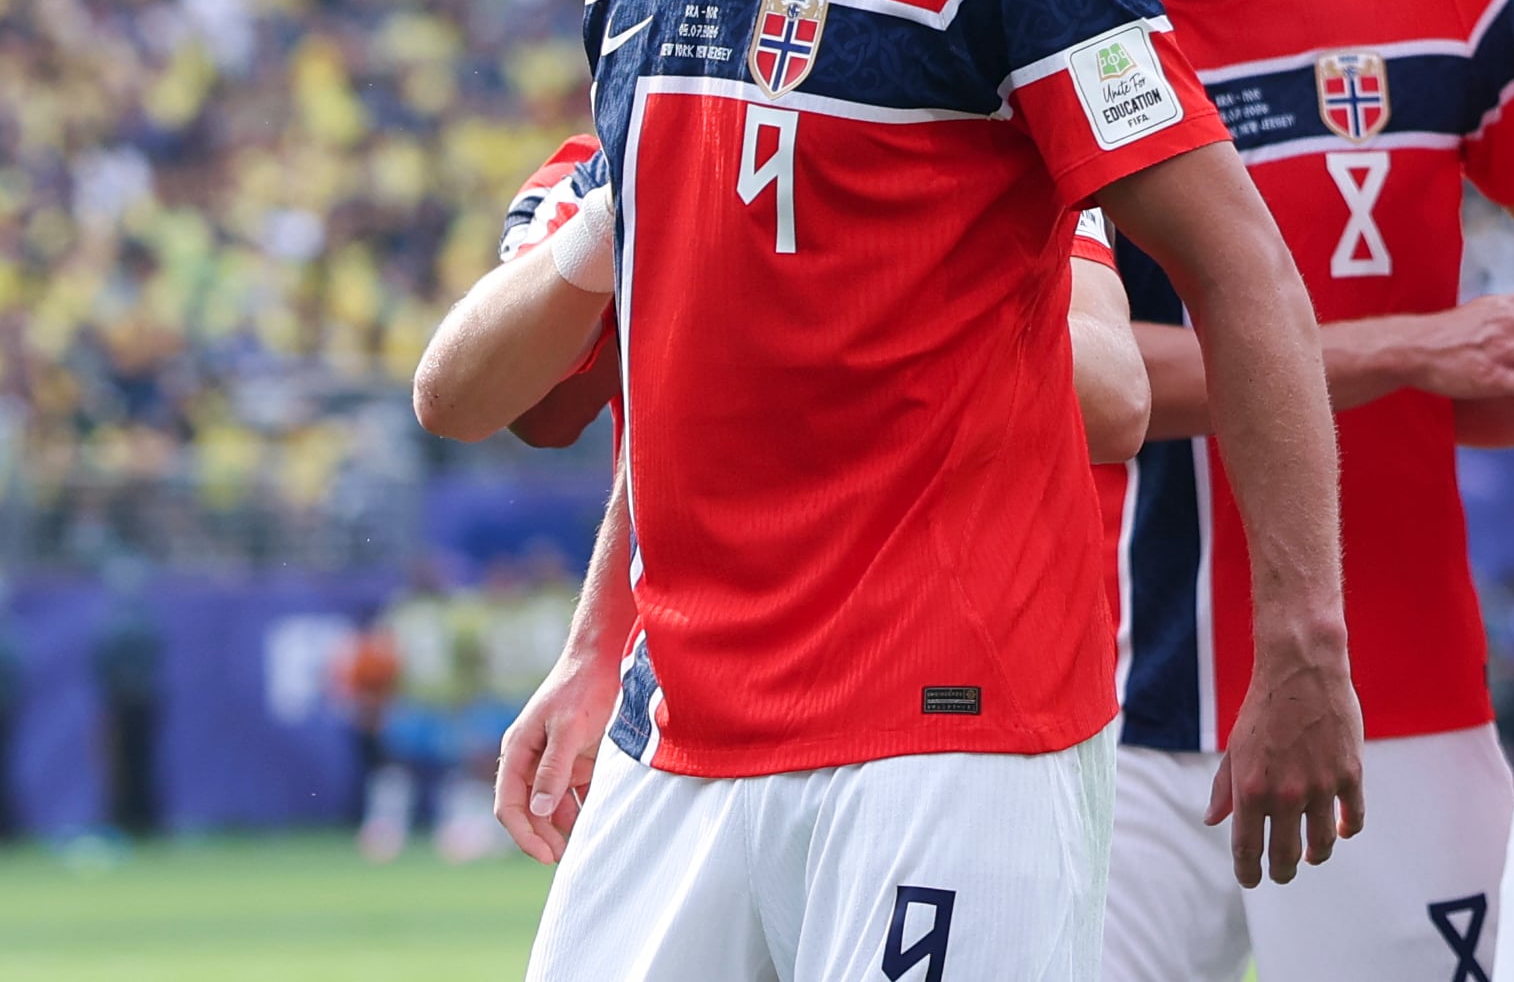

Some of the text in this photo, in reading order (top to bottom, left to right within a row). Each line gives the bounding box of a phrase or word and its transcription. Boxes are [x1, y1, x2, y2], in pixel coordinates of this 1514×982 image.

[675, 42, 696, 58] YORK
[1102, 72, 1147, 104] Unite For
[1102, 88, 1163, 125] EDUCATION
[1127, 113, 1150, 129] FIFA
[736, 103, 800, 254] 9
[1325, 150, 1393, 279] 8
[881, 885, 957, 982] 9
[1427, 892, 1491, 982] 8
